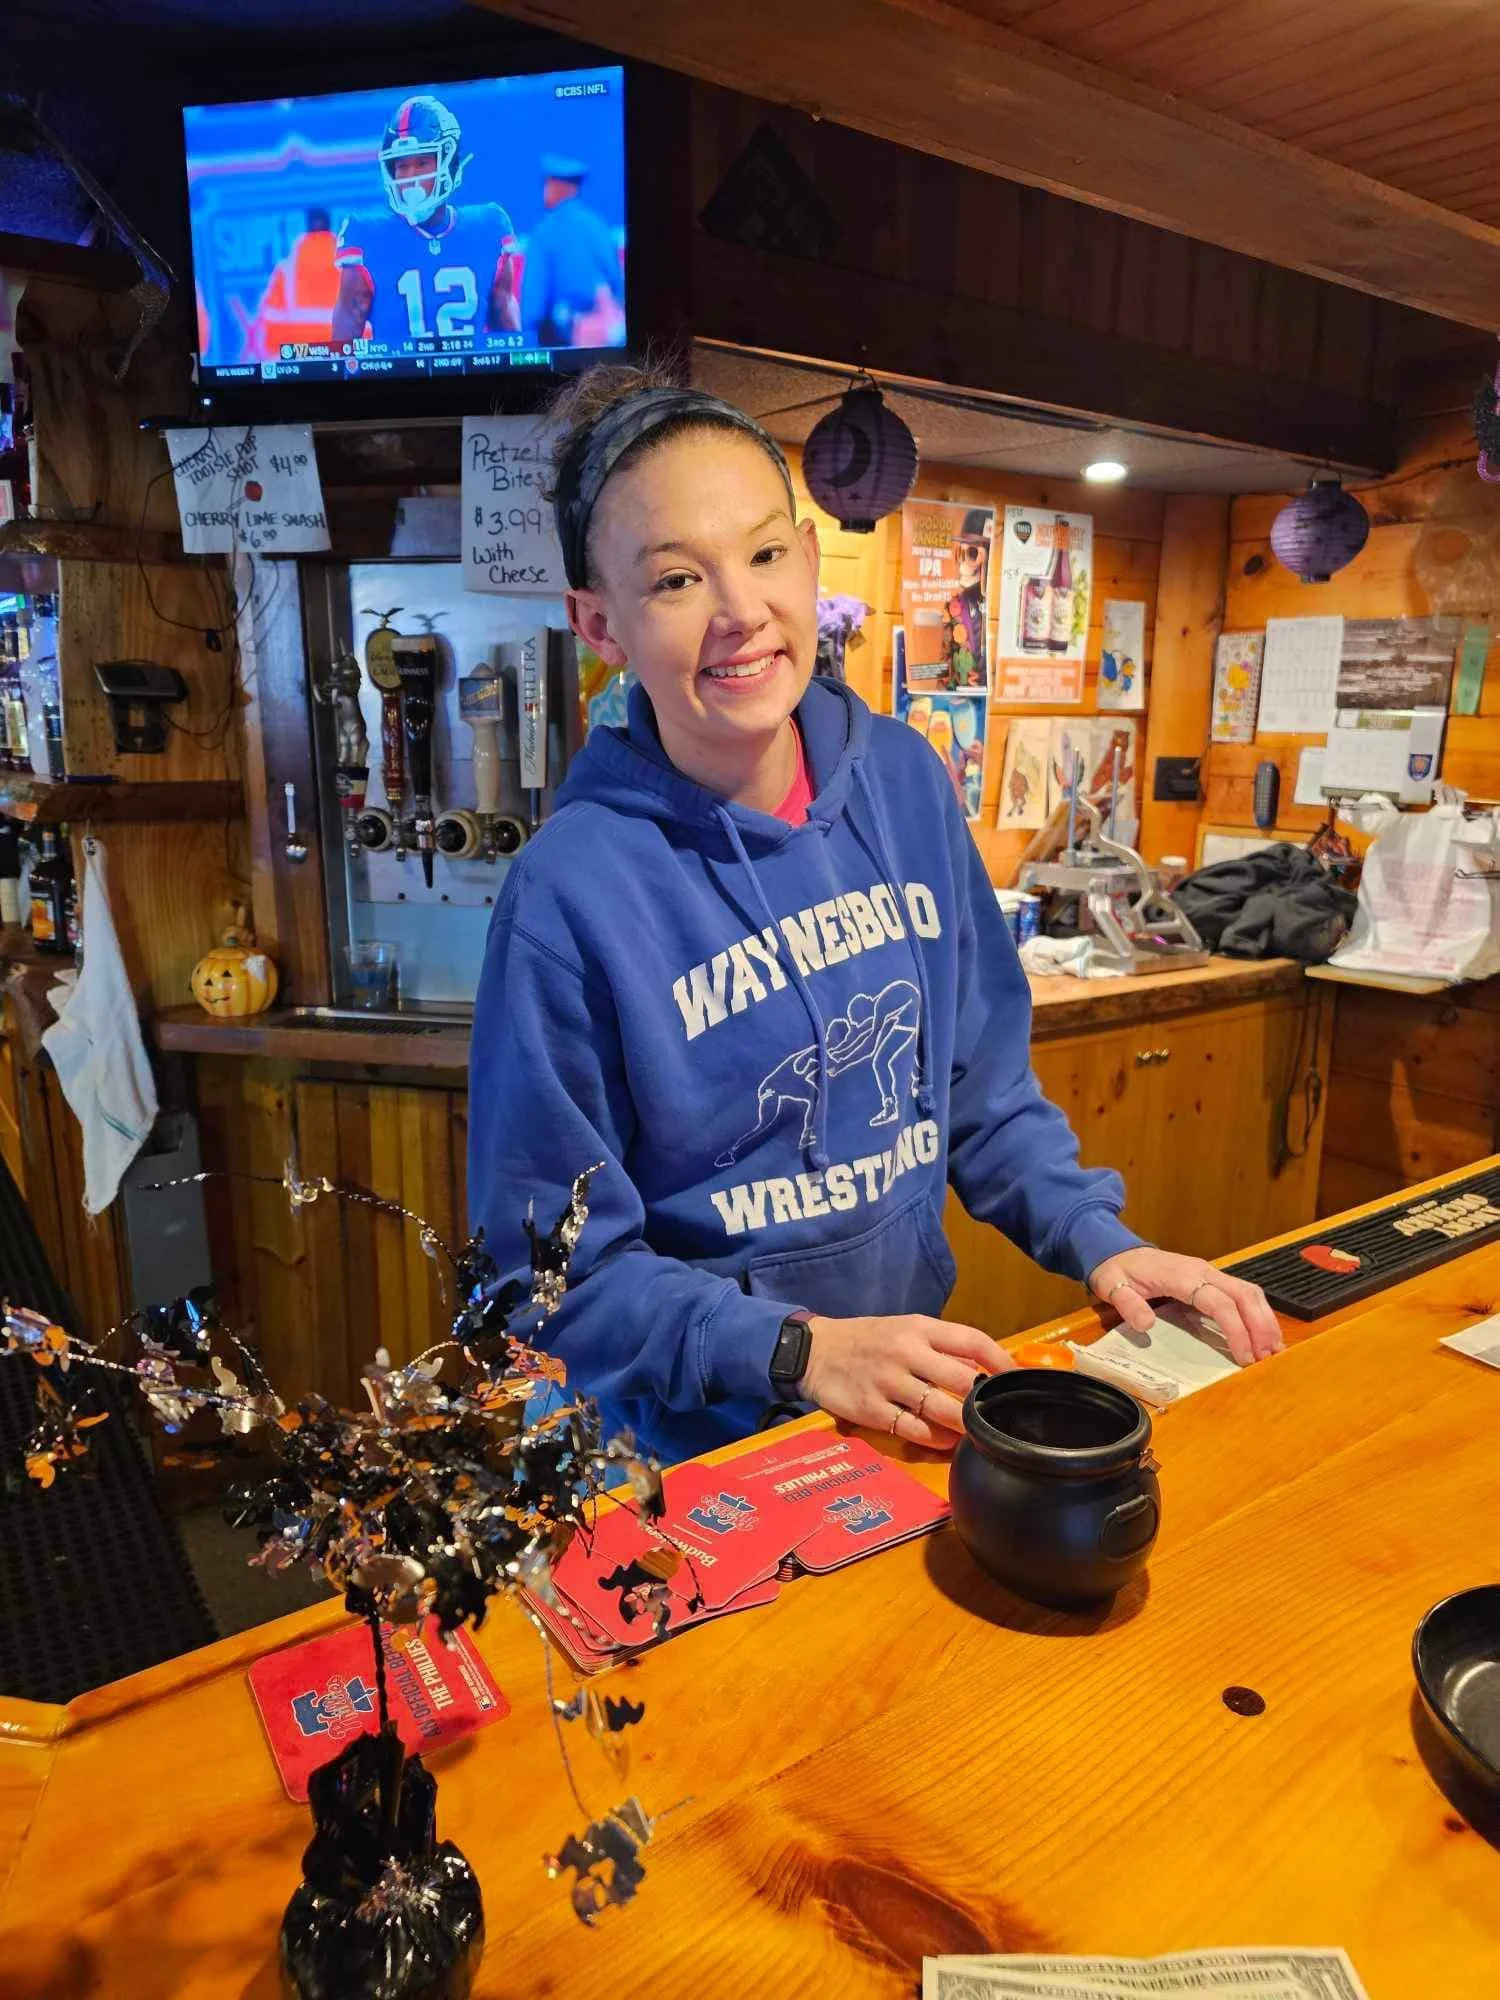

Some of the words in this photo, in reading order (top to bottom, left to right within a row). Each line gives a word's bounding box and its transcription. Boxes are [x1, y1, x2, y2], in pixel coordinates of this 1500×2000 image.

[587, 84, 607, 95] NFL
[398, 266, 478, 338] 12
[343, 344, 351, 355] 0
[517, 335, 524, 347] 2
[486, 465, 546, 492] Bites
[184, 511, 240, 529] CHERRY
[245, 511, 278, 528] LIME
[474, 506, 542, 535] $3.99
[473, 542, 514, 564] With
[489, 565, 549, 585] Cheese
[919, 558, 942, 578] IPA
[523, 637, 536, 700] ULTRA
[672, 882, 943, 1042] WAYNESBOO
[826, 1460, 855, 1476] THE
[773, 1469, 829, 1495] PHILLIES
[404, 1638, 443, 1688] PHILLIES
[394, 1668, 433, 1720] OFFICIAL
[428, 1683, 456, 1712] THE
